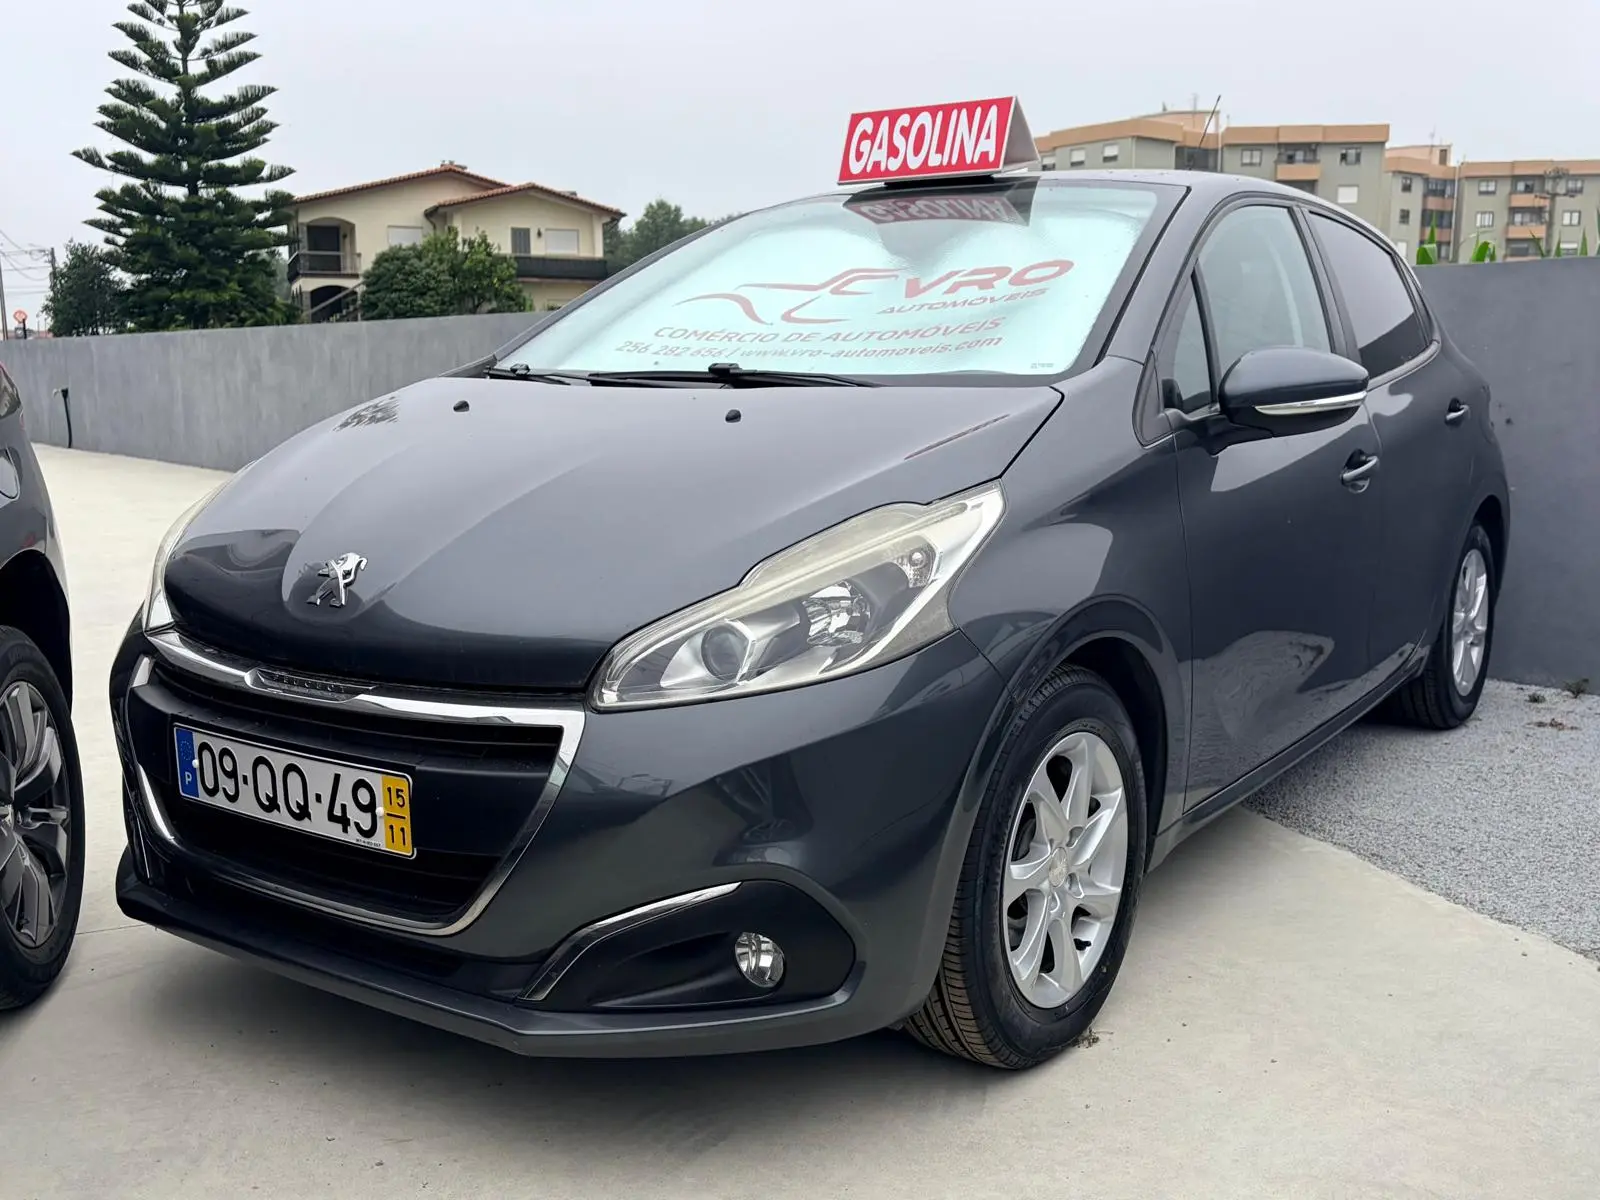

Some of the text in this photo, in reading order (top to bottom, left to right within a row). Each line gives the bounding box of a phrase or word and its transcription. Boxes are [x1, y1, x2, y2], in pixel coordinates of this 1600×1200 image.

[849, 104, 998, 175] GASOLINA
[905, 259, 1074, 298] VRO
[654, 316, 1006, 343] COMÉRCIO DE AUTOMÓVEIS
[184, 771, 193, 785] P
[386, 786, 406, 808] 15
[388, 824, 406, 847] 11
